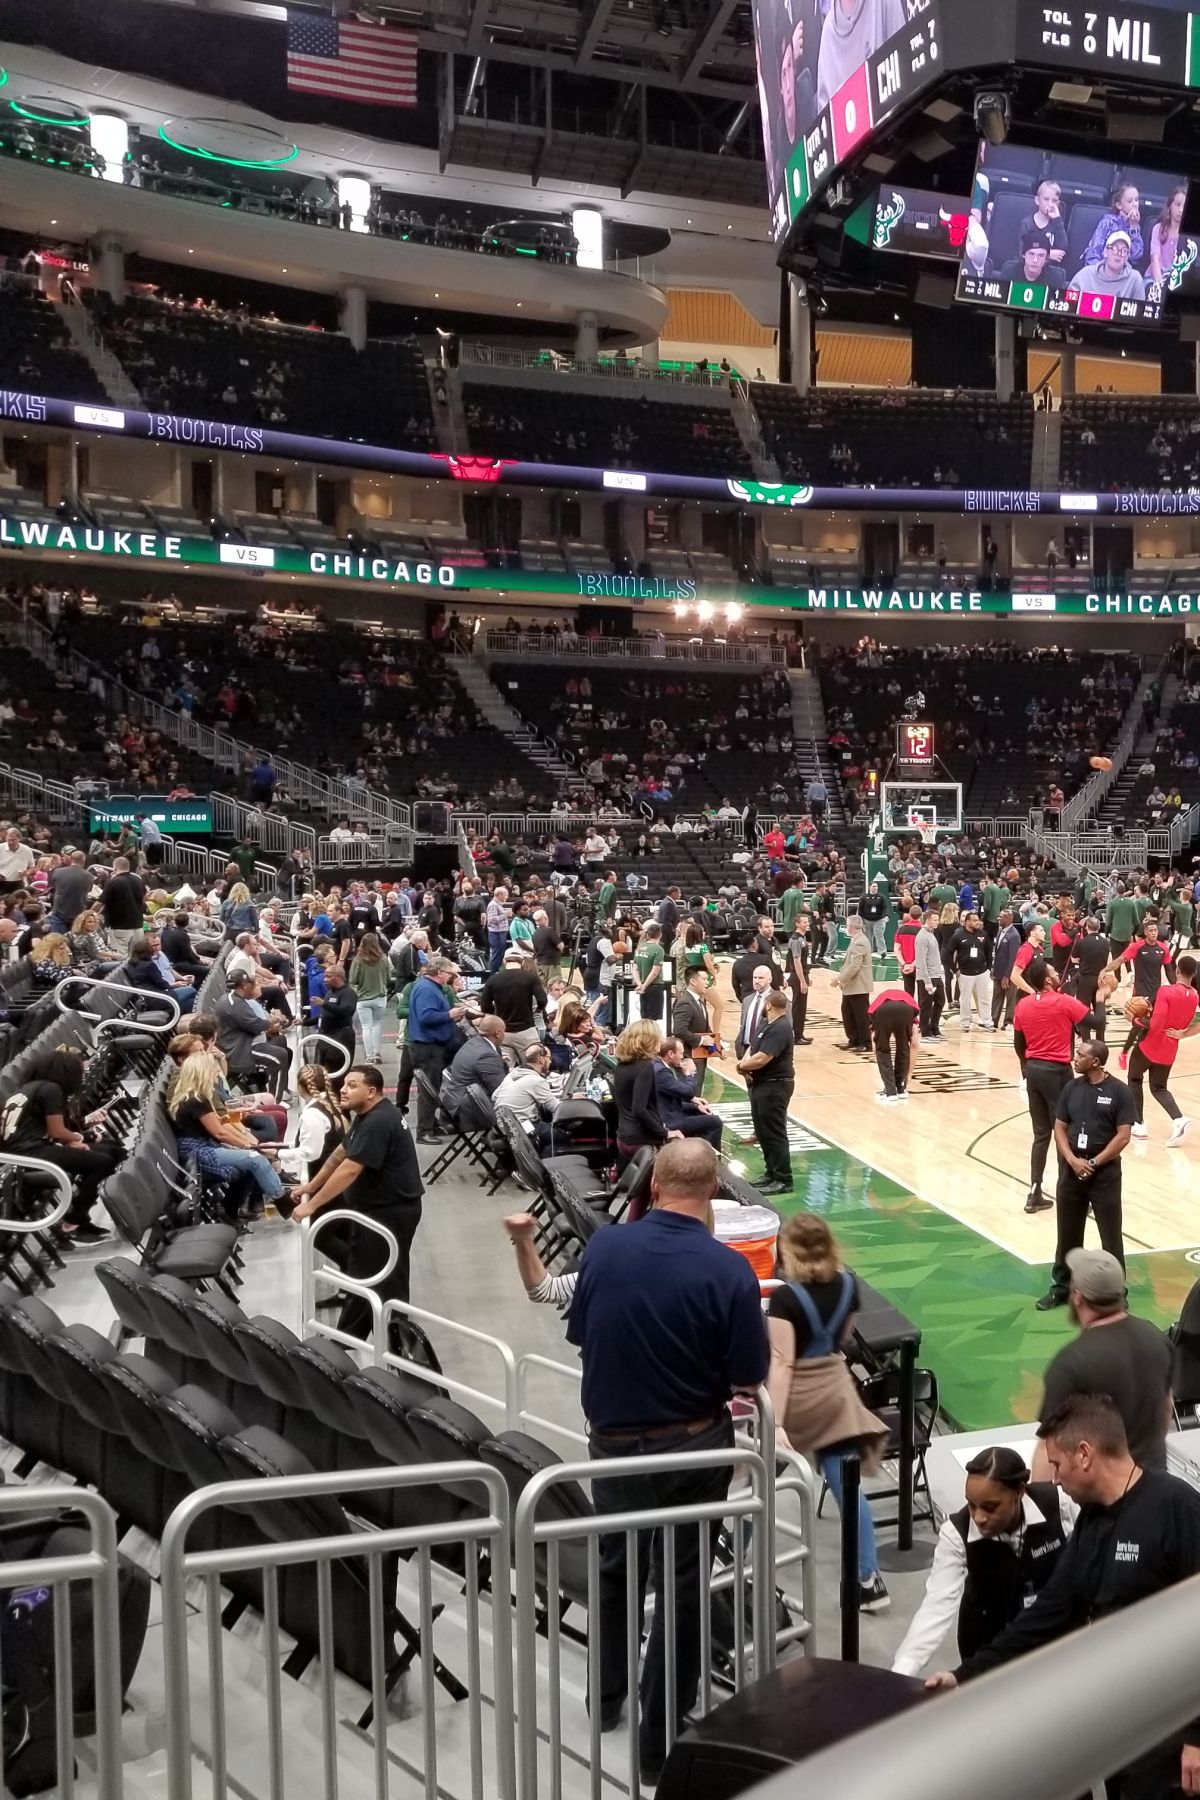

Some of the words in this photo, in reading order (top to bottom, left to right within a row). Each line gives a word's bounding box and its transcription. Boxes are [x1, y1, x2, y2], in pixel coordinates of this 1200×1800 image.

[927, 19, 936, 38] 7
[1043, 10, 1071, 26] TOL
[1085, 13, 1097, 31] 7
[1084, 35, 1097, 53] 0
[1106, 16, 1161, 65] MIL
[930, 42, 938, 60] 0
[876, 49, 901, 103] CHI
[845, 99, 857, 133] 0
[793, 167, 801, 198] 0
[984, 283, 1002, 298] MIL
[1023, 288, 1033, 302] 0
[1049, 300, 1069, 311] 6:29
[1092, 298, 1102, 312] 0
[1120, 302, 1137, 317] CHI
[148, 413, 264, 451] BULLS
[964, 490, 1040, 512] BUCKS
[0, 518, 182, 558] LWAUKEE
[236, 549, 258, 561] VS
[310, 552, 456, 586] CHICAGO
[578, 573, 697, 601] BULLS
[808, 589, 982, 611] MILWAUKEE
[1025, 597, 1043, 608] VS
[907, 727, 929, 739] 6:29
[911, 737, 926, 755] 12
